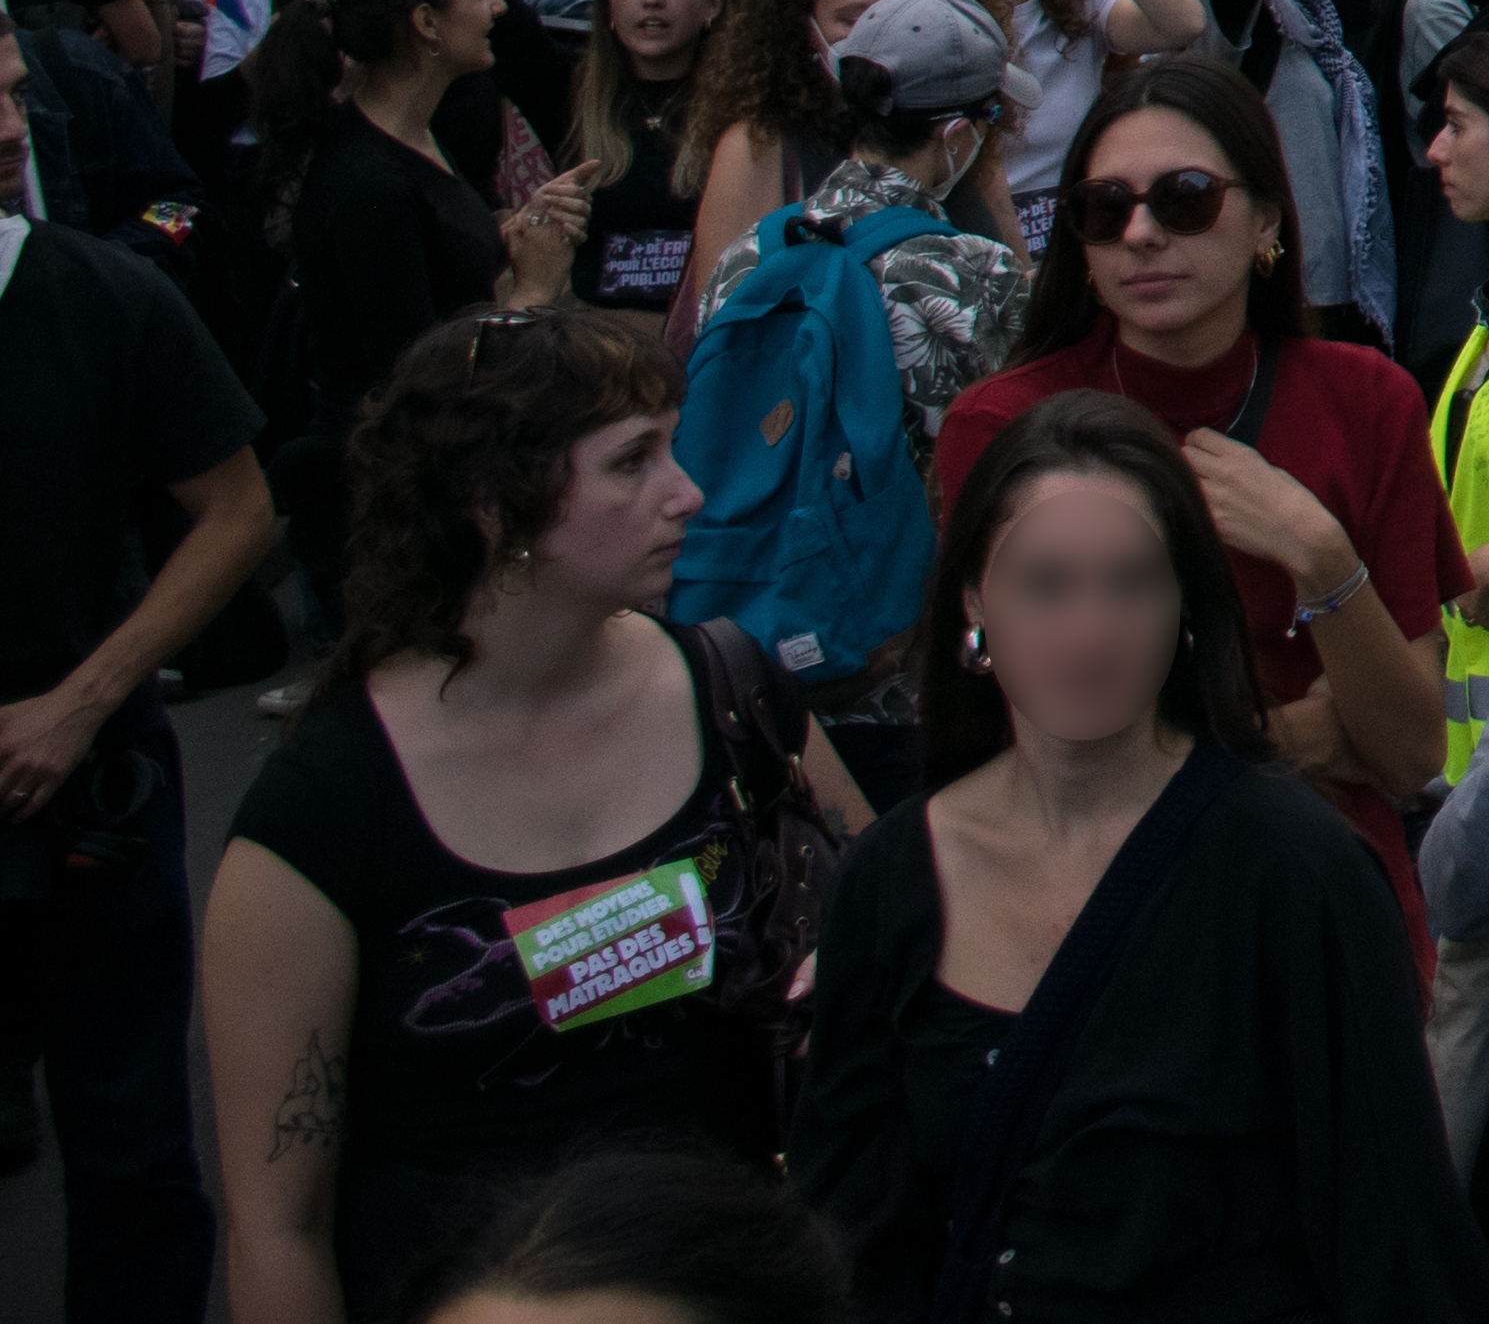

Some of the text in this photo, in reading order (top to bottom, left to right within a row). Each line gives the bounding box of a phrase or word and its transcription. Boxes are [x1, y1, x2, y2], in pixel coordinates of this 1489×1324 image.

[608, 260, 639, 272] POUR
[647, 241, 663, 255] DE
[535, 879, 655, 946] DES MOYENS
[531, 931, 593, 971] POUR
[547, 932, 696, 1021] MATRAQUES
[569, 922, 668, 984] PAS DES
